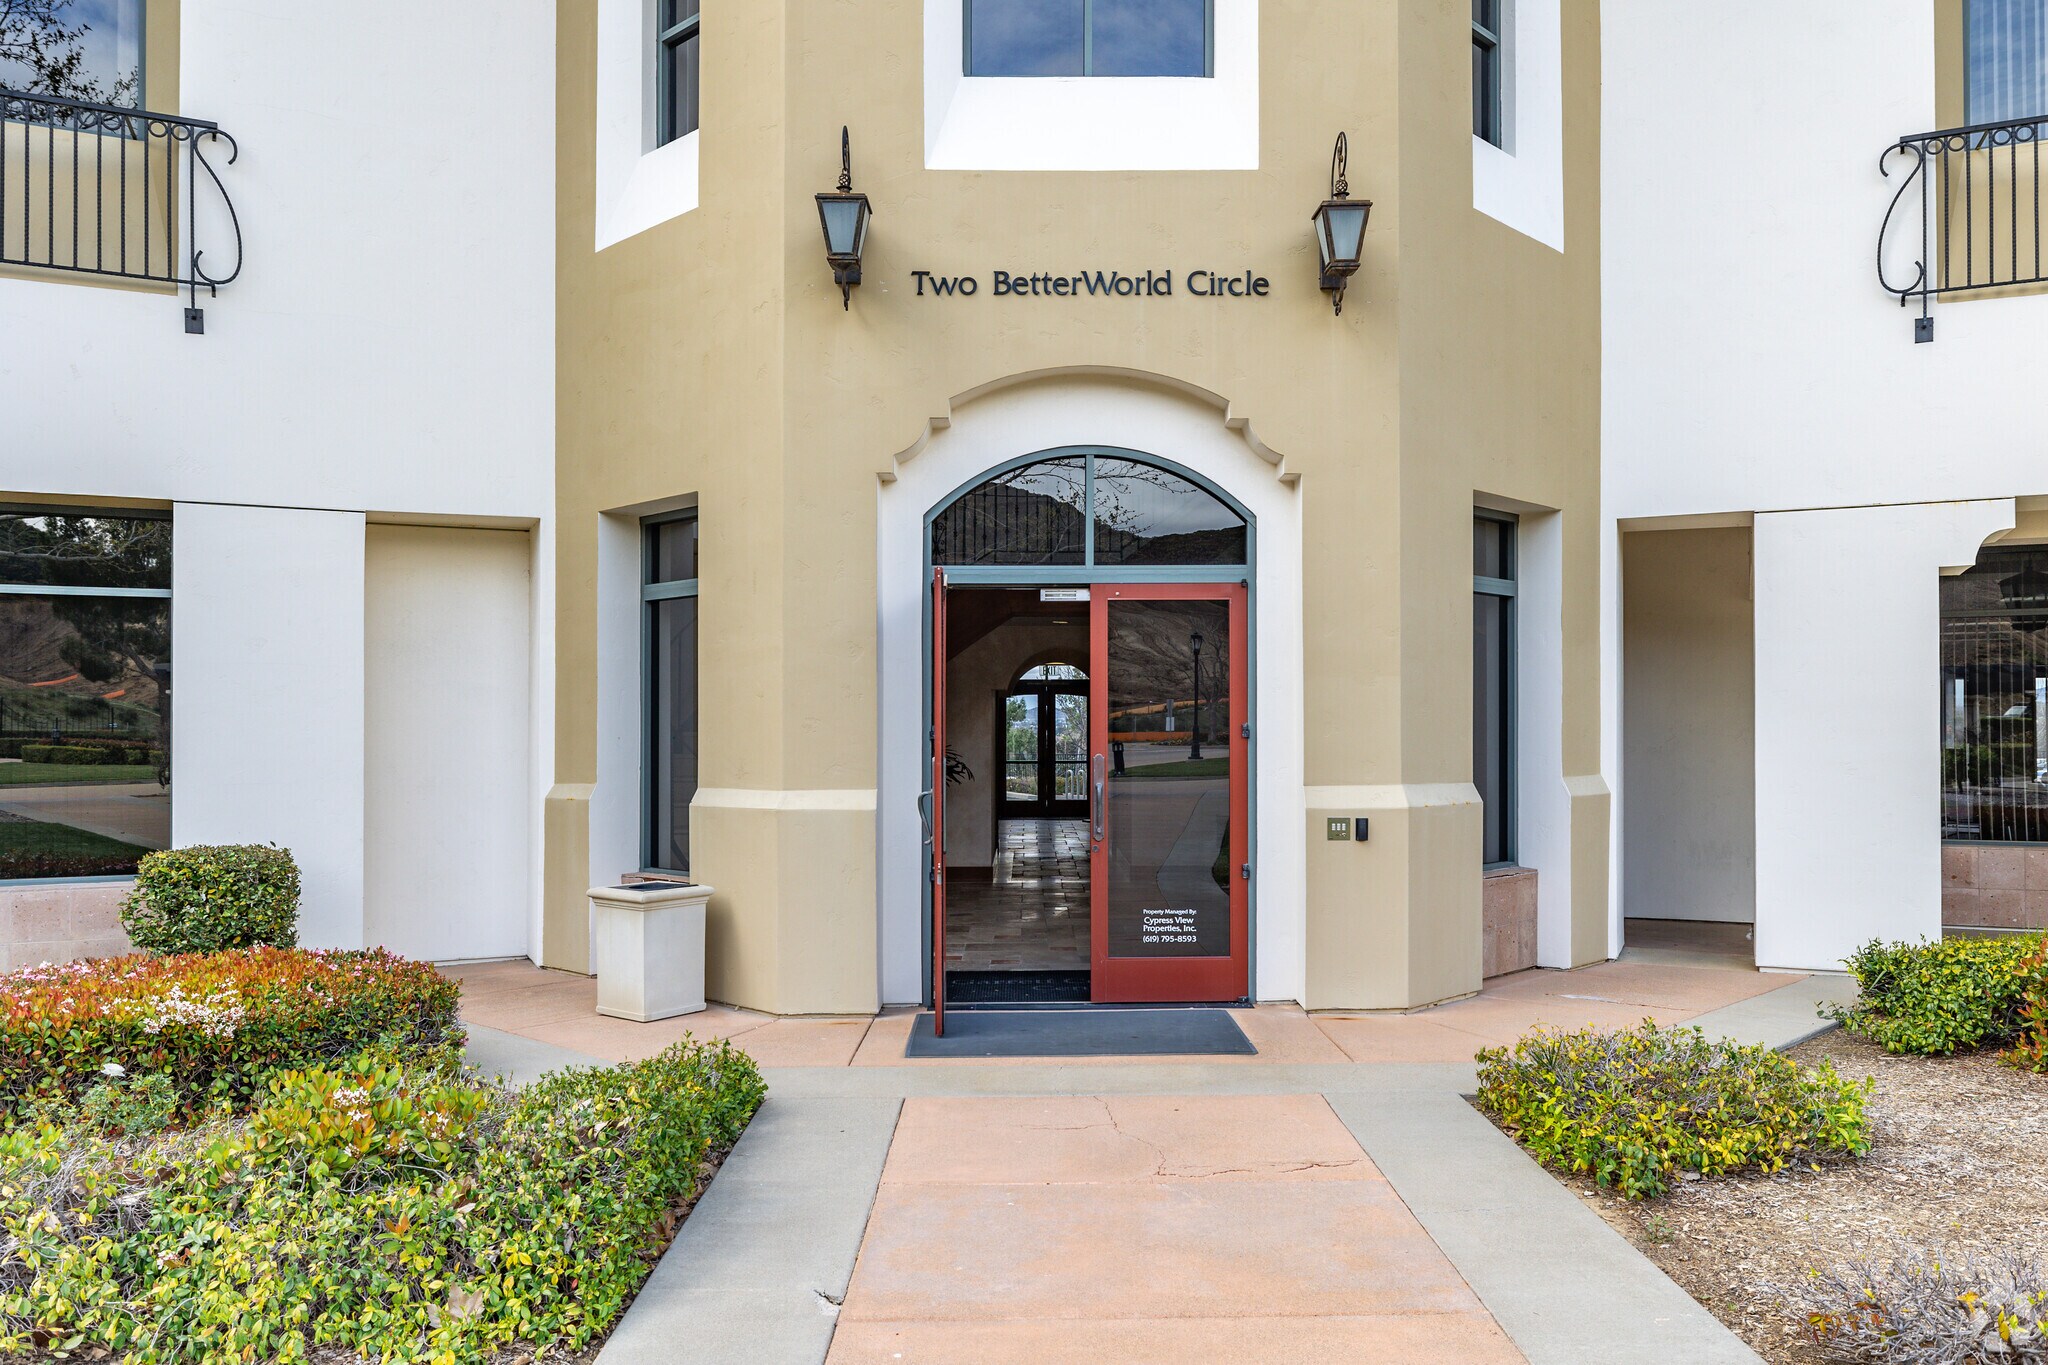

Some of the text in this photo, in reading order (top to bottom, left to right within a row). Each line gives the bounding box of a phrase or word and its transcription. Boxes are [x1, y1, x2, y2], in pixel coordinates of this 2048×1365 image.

[911, 270, 1270, 296] Two BetterWorld Circle
[1042, 666, 1056, 675] EXIT
[1143, 916, 1194, 925] Cypress View
[1143, 924, 1197, 933] Properties, Inc.
[1142, 935, 1197, 943] (619) 795-8593
